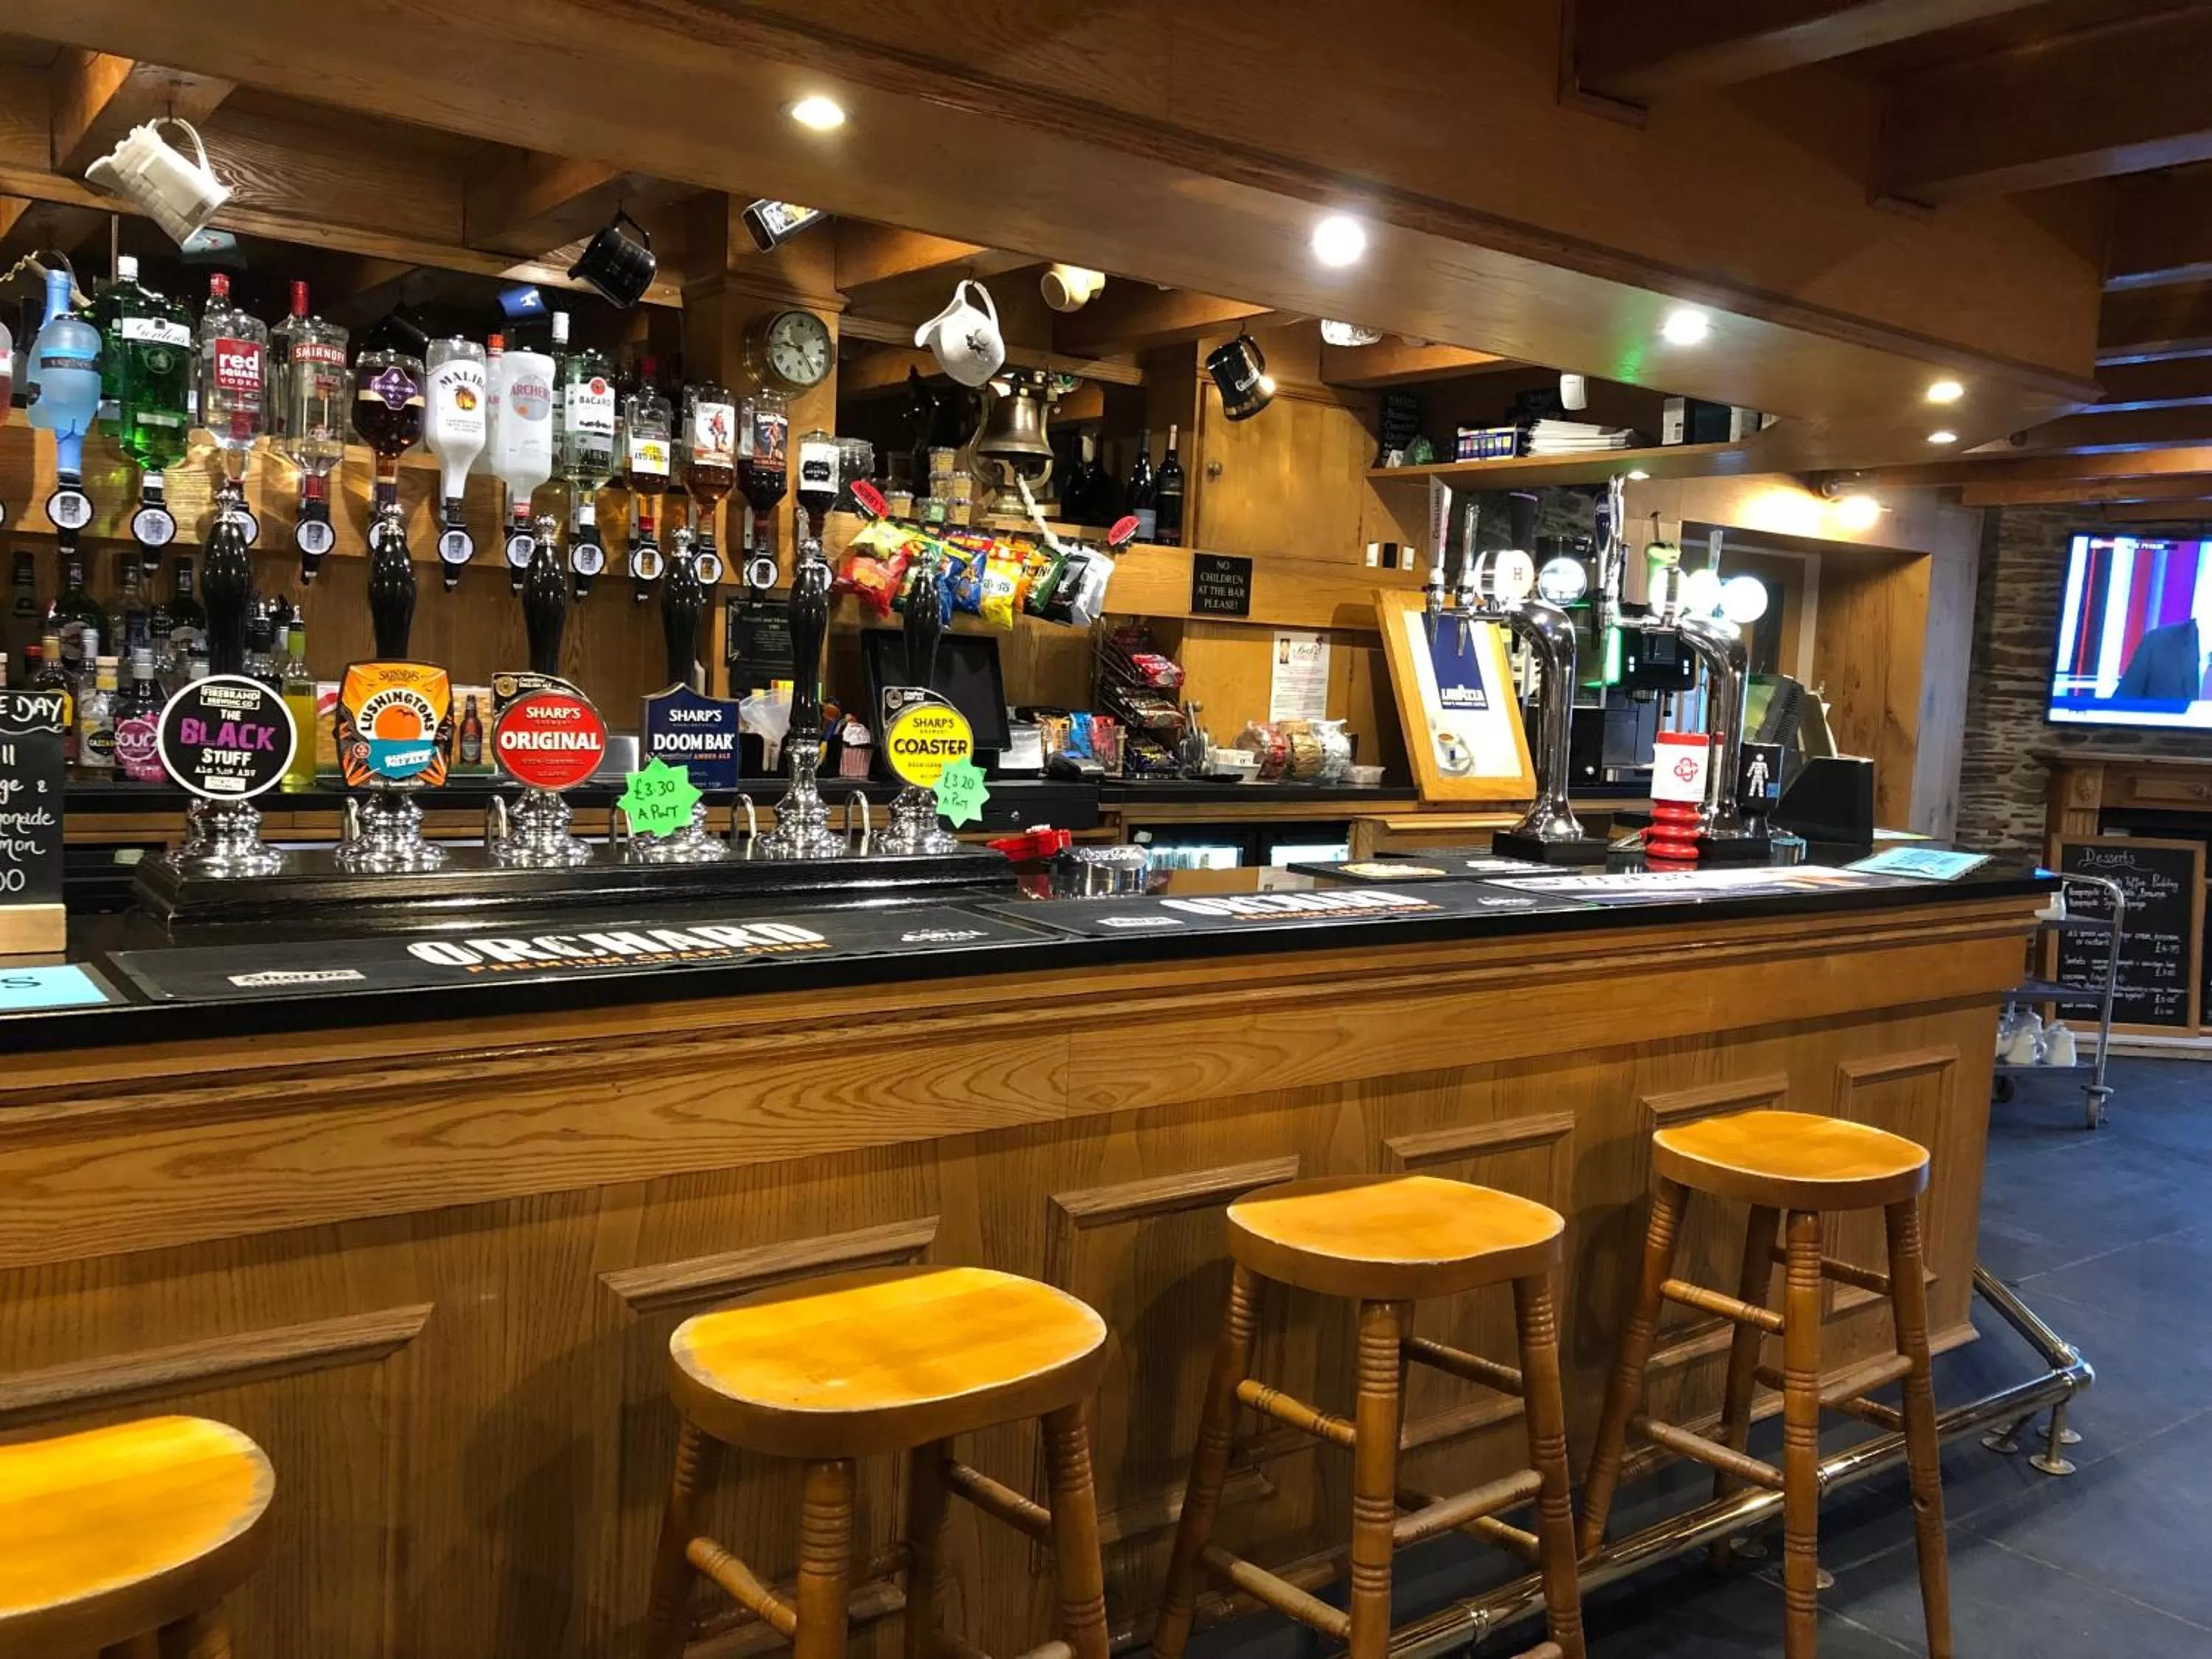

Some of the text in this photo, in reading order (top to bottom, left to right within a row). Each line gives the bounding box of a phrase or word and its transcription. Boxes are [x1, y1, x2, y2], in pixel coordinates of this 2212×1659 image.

[219, 350, 259, 369] red
[220, 377, 259, 387] VODKA
[579, 395, 611, 407] BACARD
[1216, 560, 1231, 571] NO
[1200, 572, 1244, 585] CHILDREN
[1198, 585, 1245, 599] AT THE BAR
[203, 689, 257, 700] FIREBRAND
[11, 695, 63, 722] DAY
[220, 709, 242, 720] THE
[361, 692, 434, 731] LUSHINGTONS
[526, 707, 581, 719] SHARP'S
[669, 709, 722, 722] SHARP'S
[913, 717, 955, 728] SHARP'S
[181, 717, 276, 752] BLACK
[501, 731, 601, 750] ORIGINAL
[653, 734, 735, 751] DOOM BAR
[894, 739, 968, 755] COASTER
[201, 748, 252, 766] STUFF
[639, 809, 648, 819] A
[2084, 849, 2136, 864] Desserts
[406, 923, 826, 966] ORCHARD
